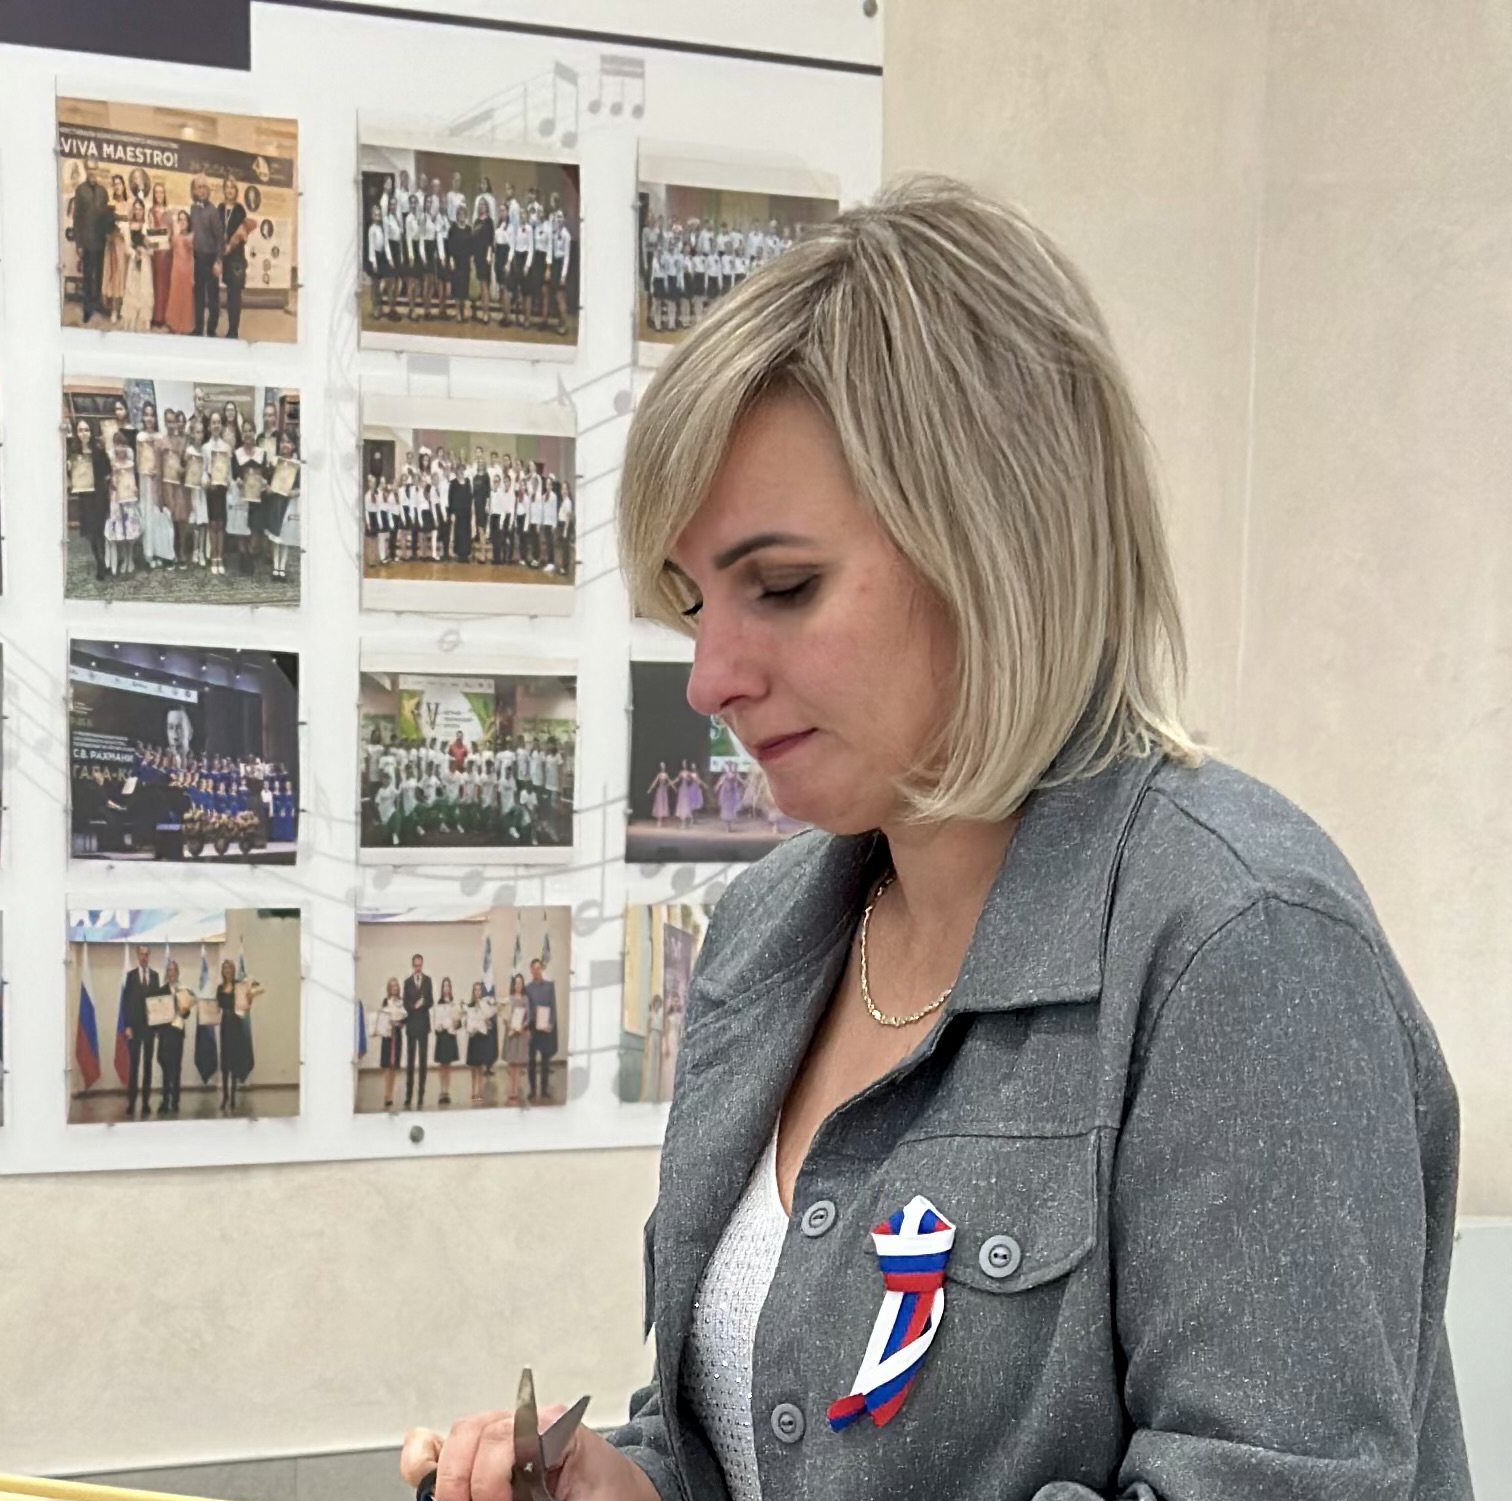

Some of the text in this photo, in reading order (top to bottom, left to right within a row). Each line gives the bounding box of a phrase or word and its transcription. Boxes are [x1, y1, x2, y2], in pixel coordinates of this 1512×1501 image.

[60, 136, 98, 157] VIVA
[102, 143, 178, 169] MAESTRO!
[90, 750, 134, 763] РАХМАНИ
